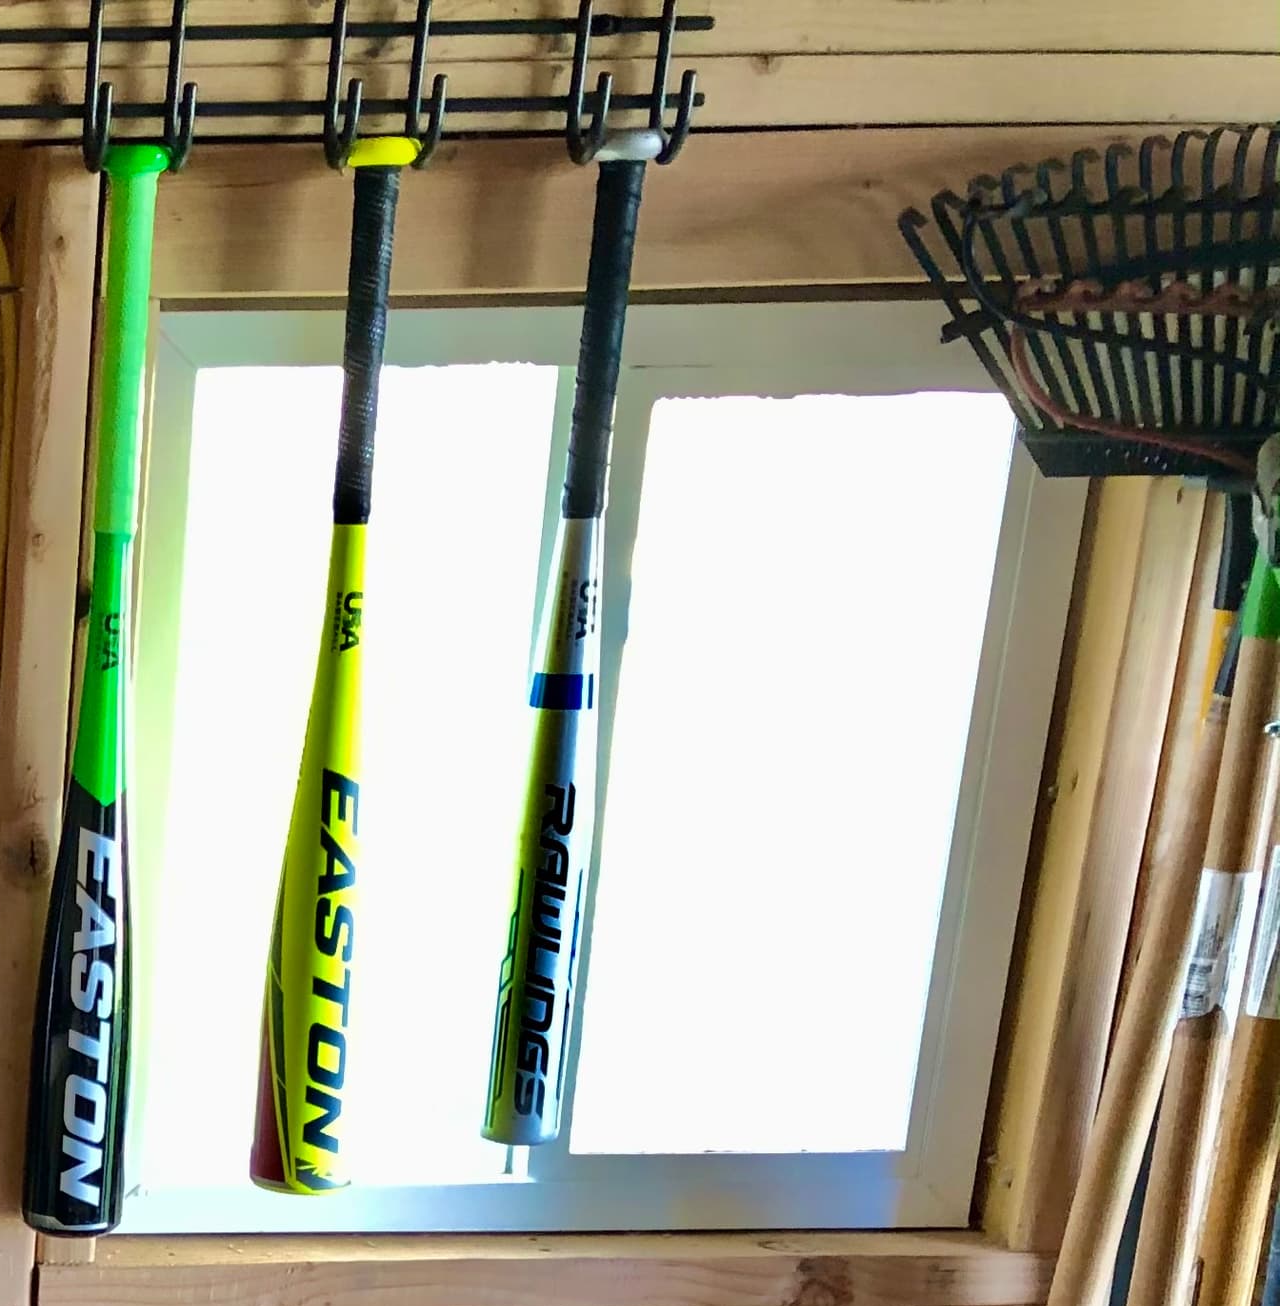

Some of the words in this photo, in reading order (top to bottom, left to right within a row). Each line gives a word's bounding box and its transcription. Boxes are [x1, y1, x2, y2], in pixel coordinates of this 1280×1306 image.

[339, 591, 363, 652] USA
[59, 825, 117, 1209] EASTON
[303, 768, 359, 1152] EASTON
[513, 782, 576, 1119] RAWLINGS
